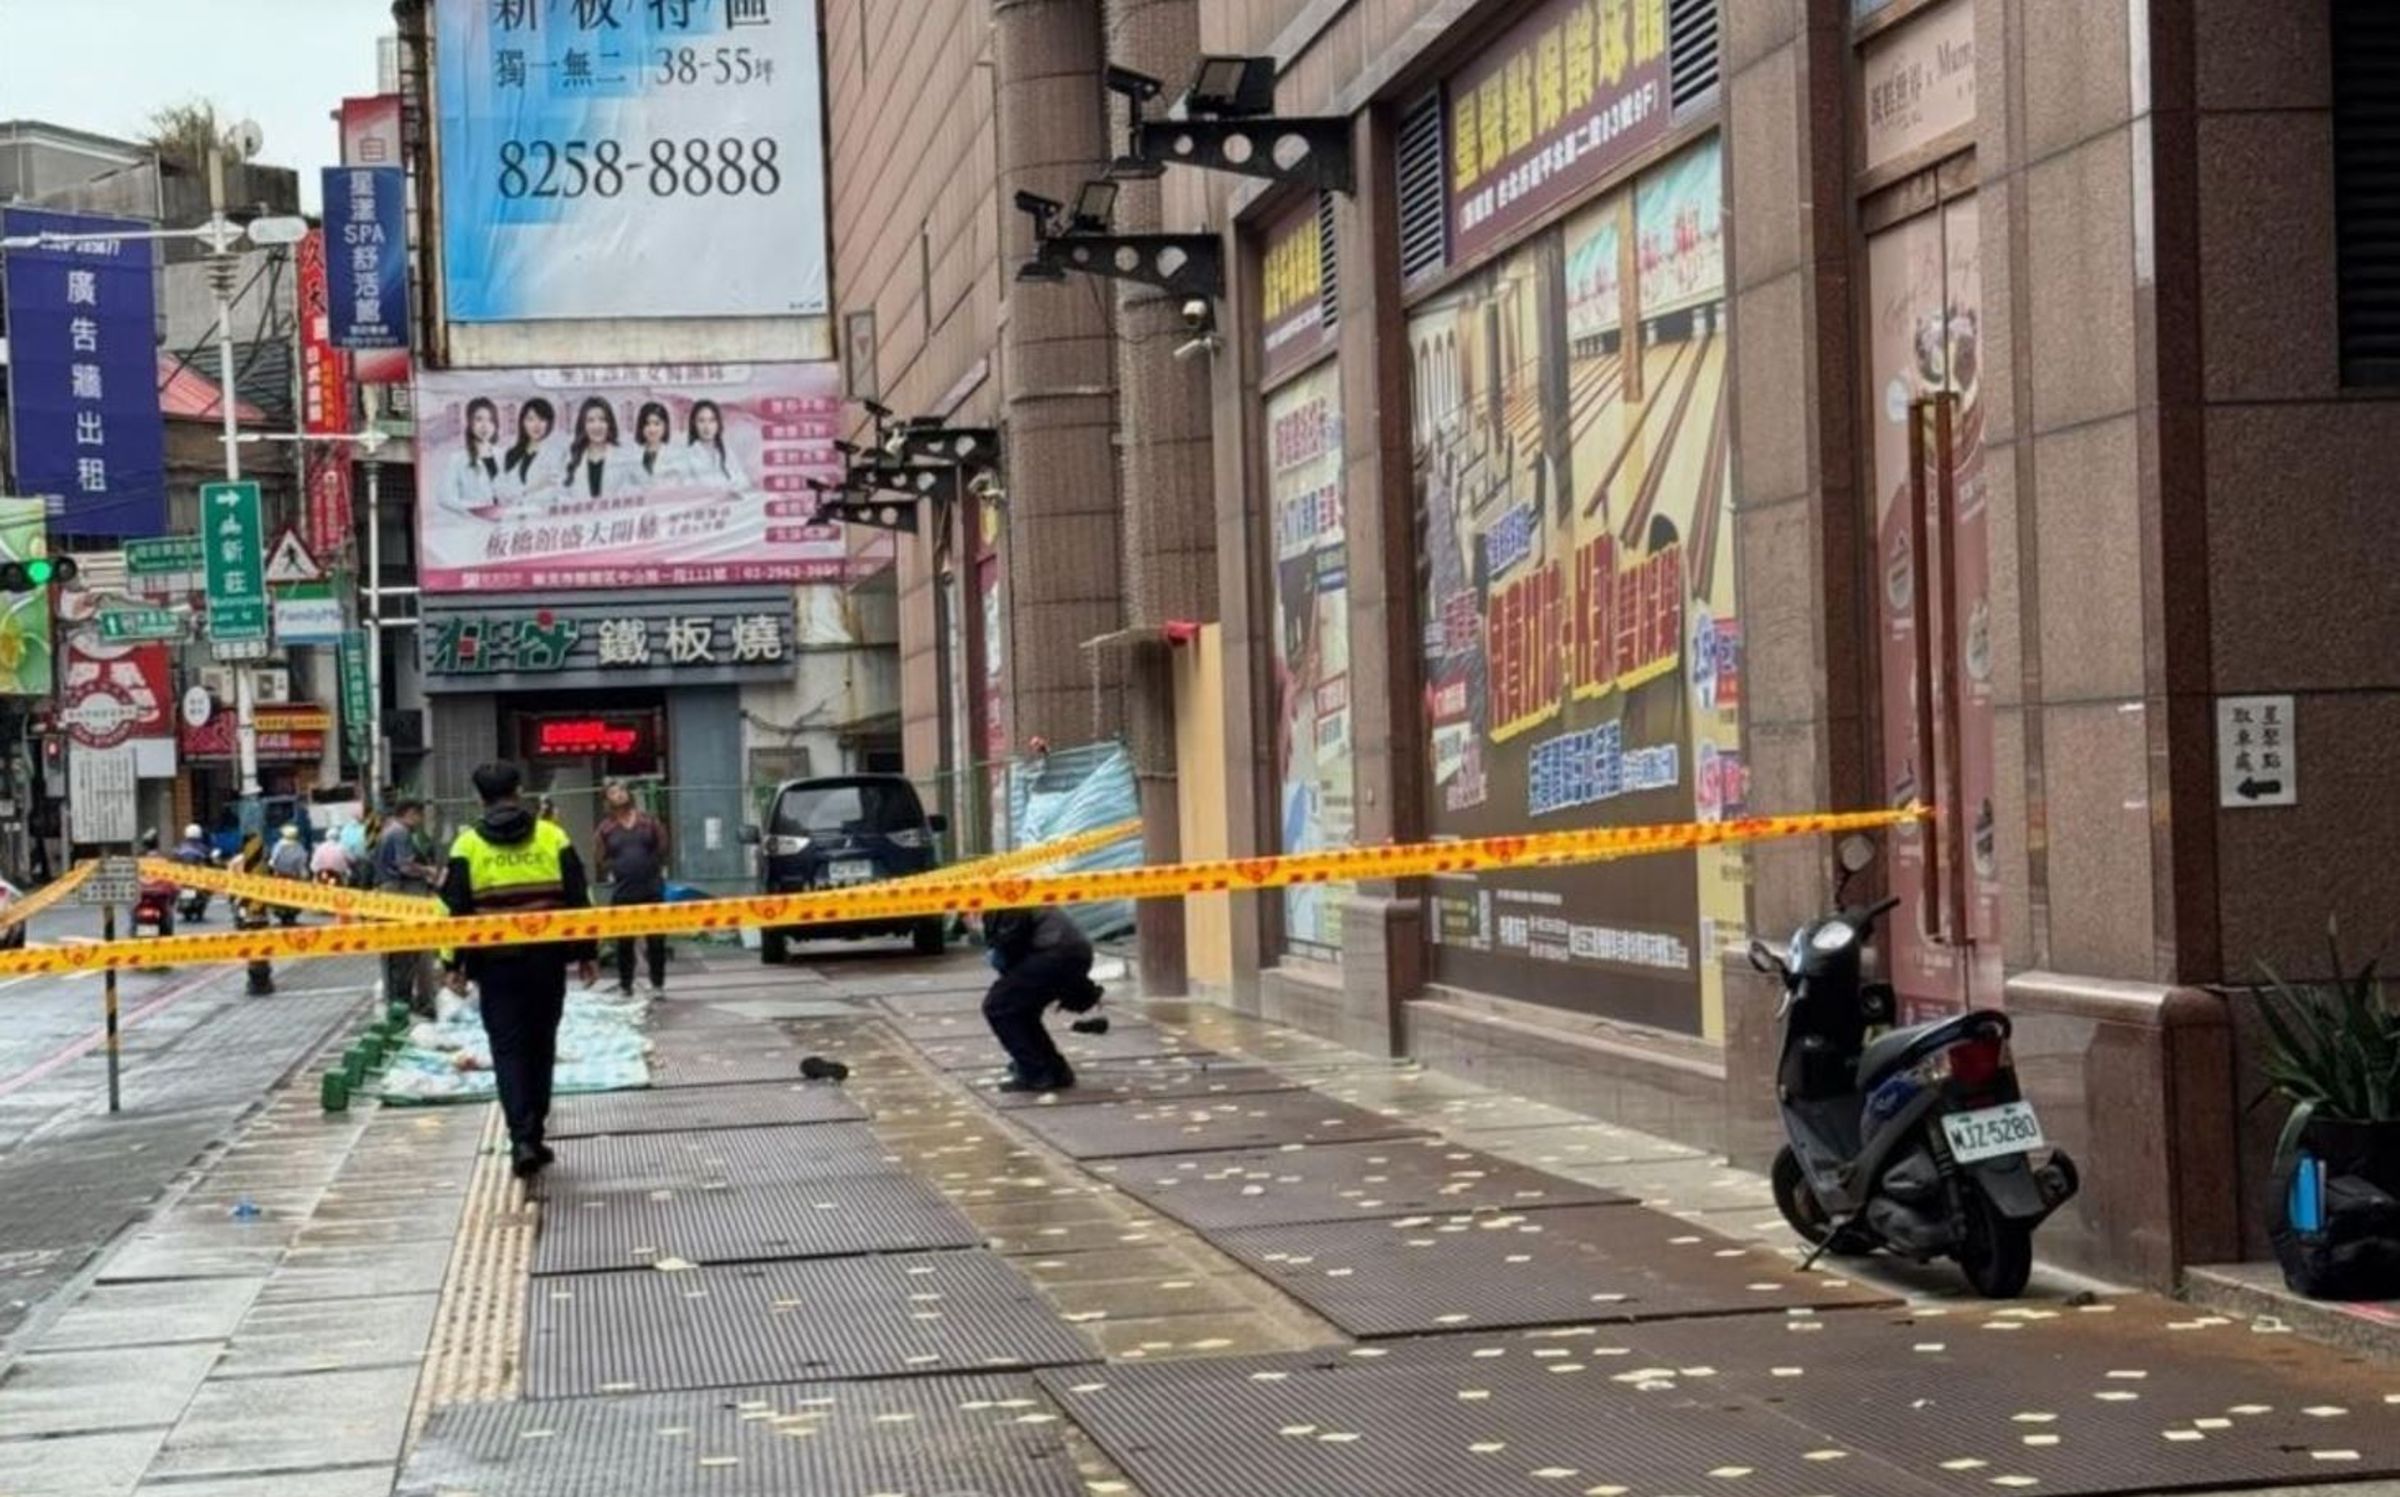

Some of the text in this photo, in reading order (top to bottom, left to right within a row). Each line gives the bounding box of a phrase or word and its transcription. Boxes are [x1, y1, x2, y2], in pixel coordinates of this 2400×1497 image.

[495, 49, 627, 88] 獨一無二
[500, 137, 781, 199] 8258-8888
[66, 269, 108, 492] 廣告牆出租
[599, 614, 784, 664] 鐵板燒
[483, 850, 547, 868] POLICE
